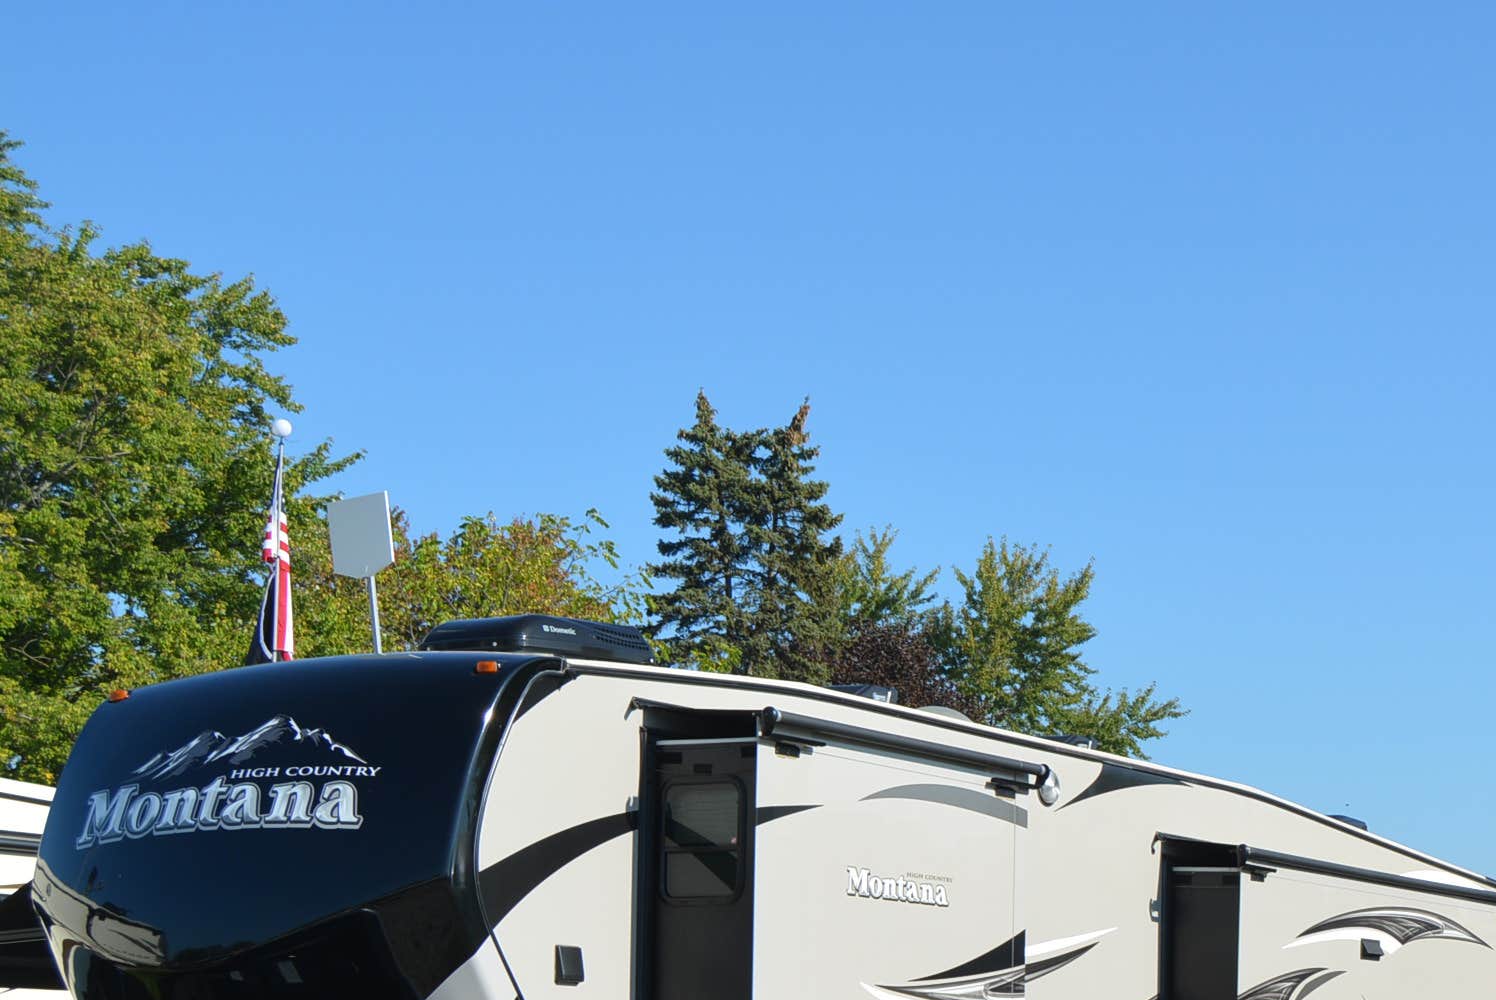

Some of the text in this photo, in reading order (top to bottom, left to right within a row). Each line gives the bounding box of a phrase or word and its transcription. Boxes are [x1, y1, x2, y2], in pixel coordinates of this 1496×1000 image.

[550, 625, 577, 636] Dometic
[231, 765, 383, 779] HIGH COUNTRY
[76, 776, 364, 850] Montana
[846, 865, 949, 908] Montana
